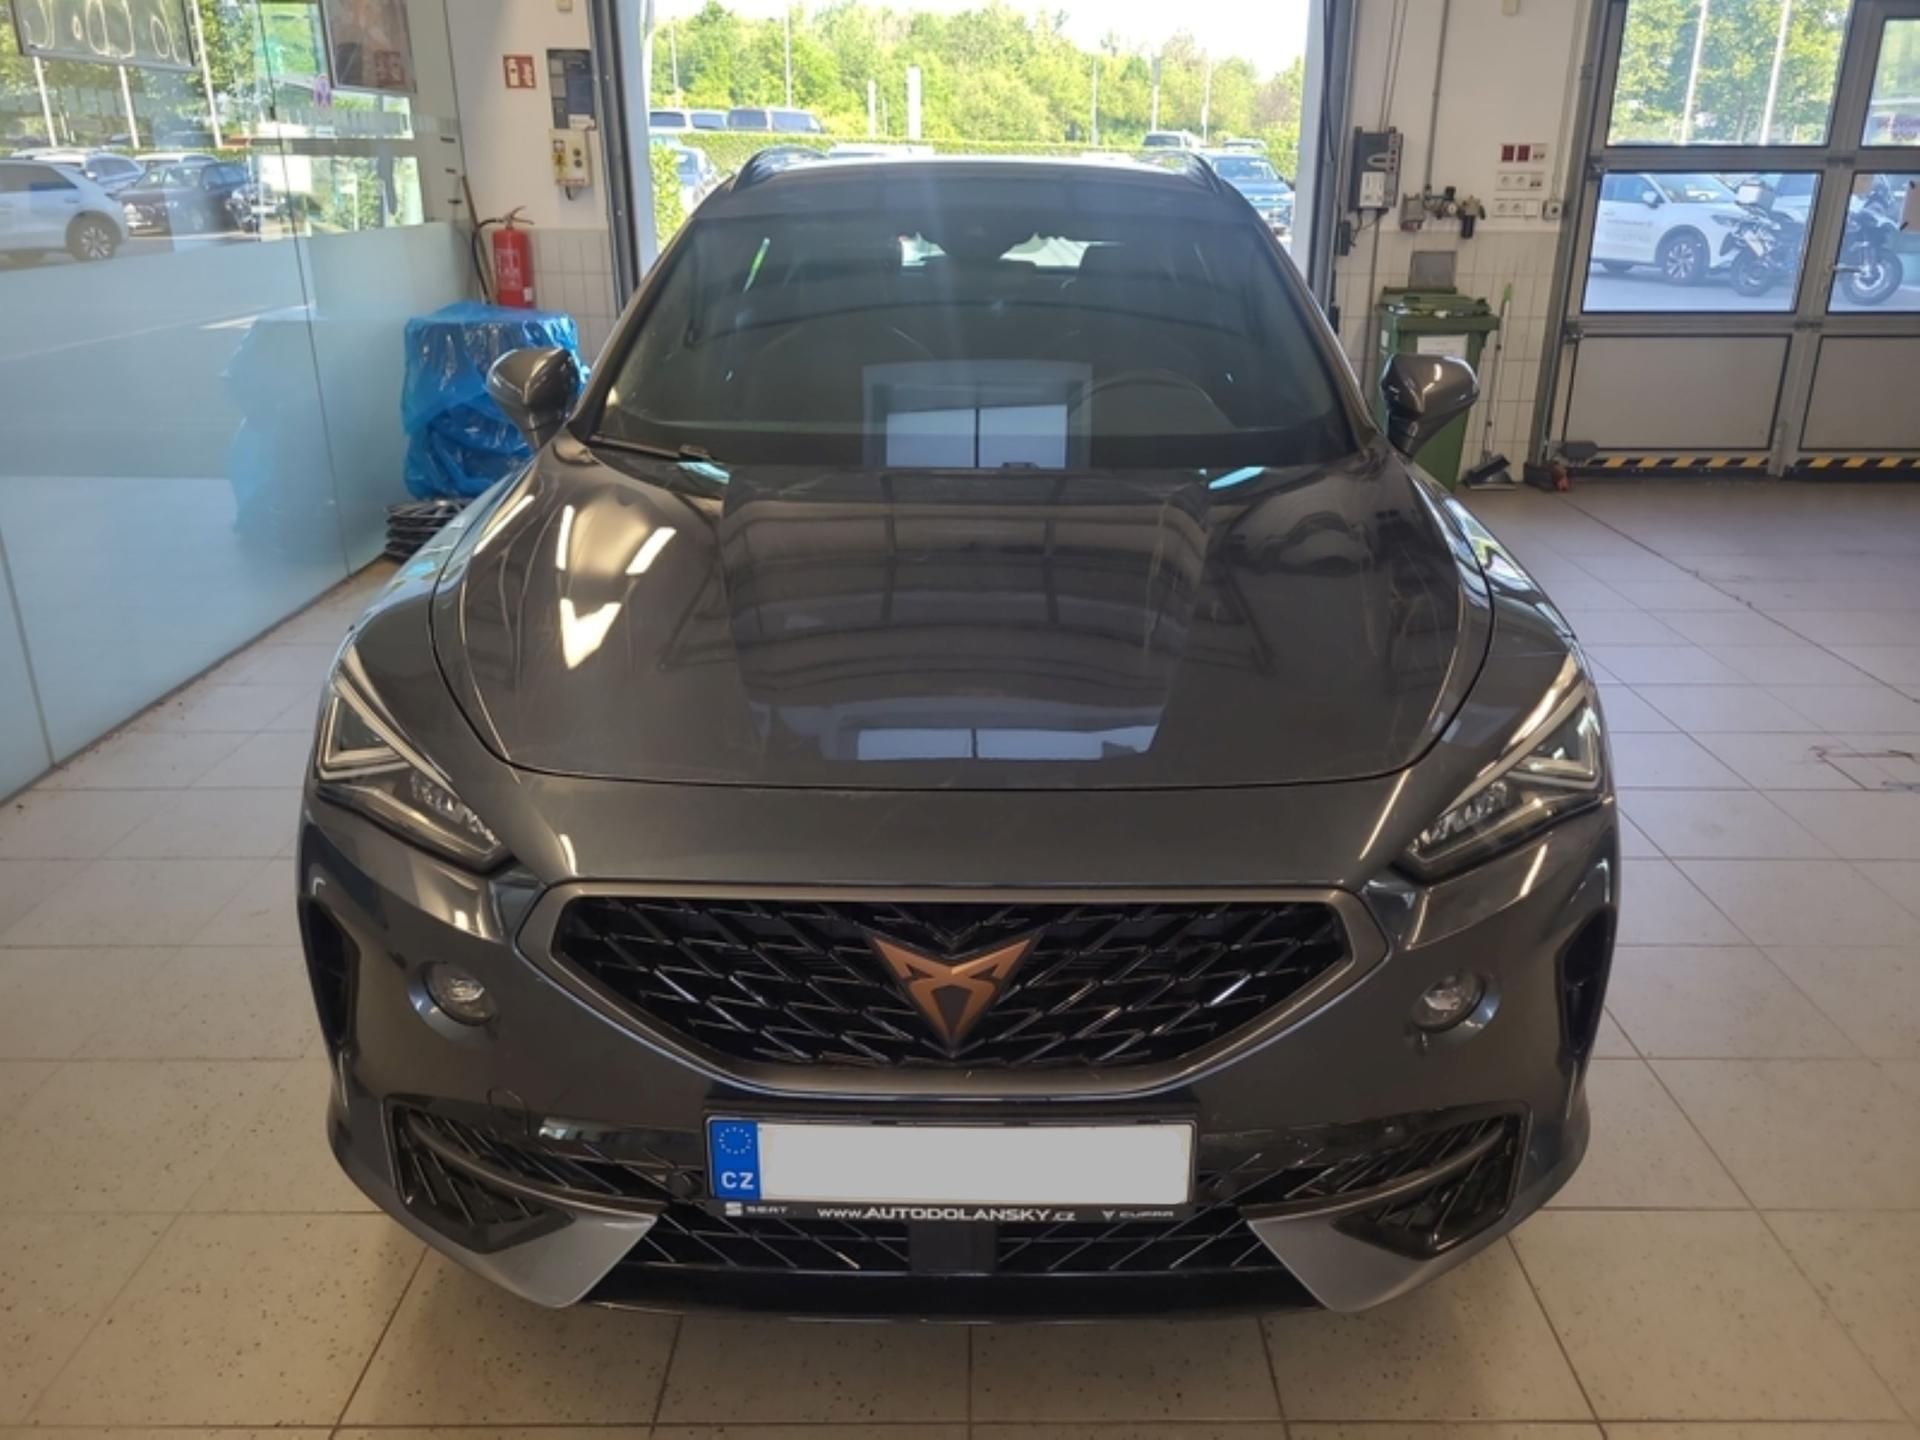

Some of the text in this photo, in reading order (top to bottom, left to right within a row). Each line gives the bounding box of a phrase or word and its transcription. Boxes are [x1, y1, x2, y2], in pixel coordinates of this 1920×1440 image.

[720, 1171, 755, 1190] CZ
[746, 1205, 788, 1215] SEAT
[816, 1206, 1076, 1221] www.AUTODOLANSKY.cz
